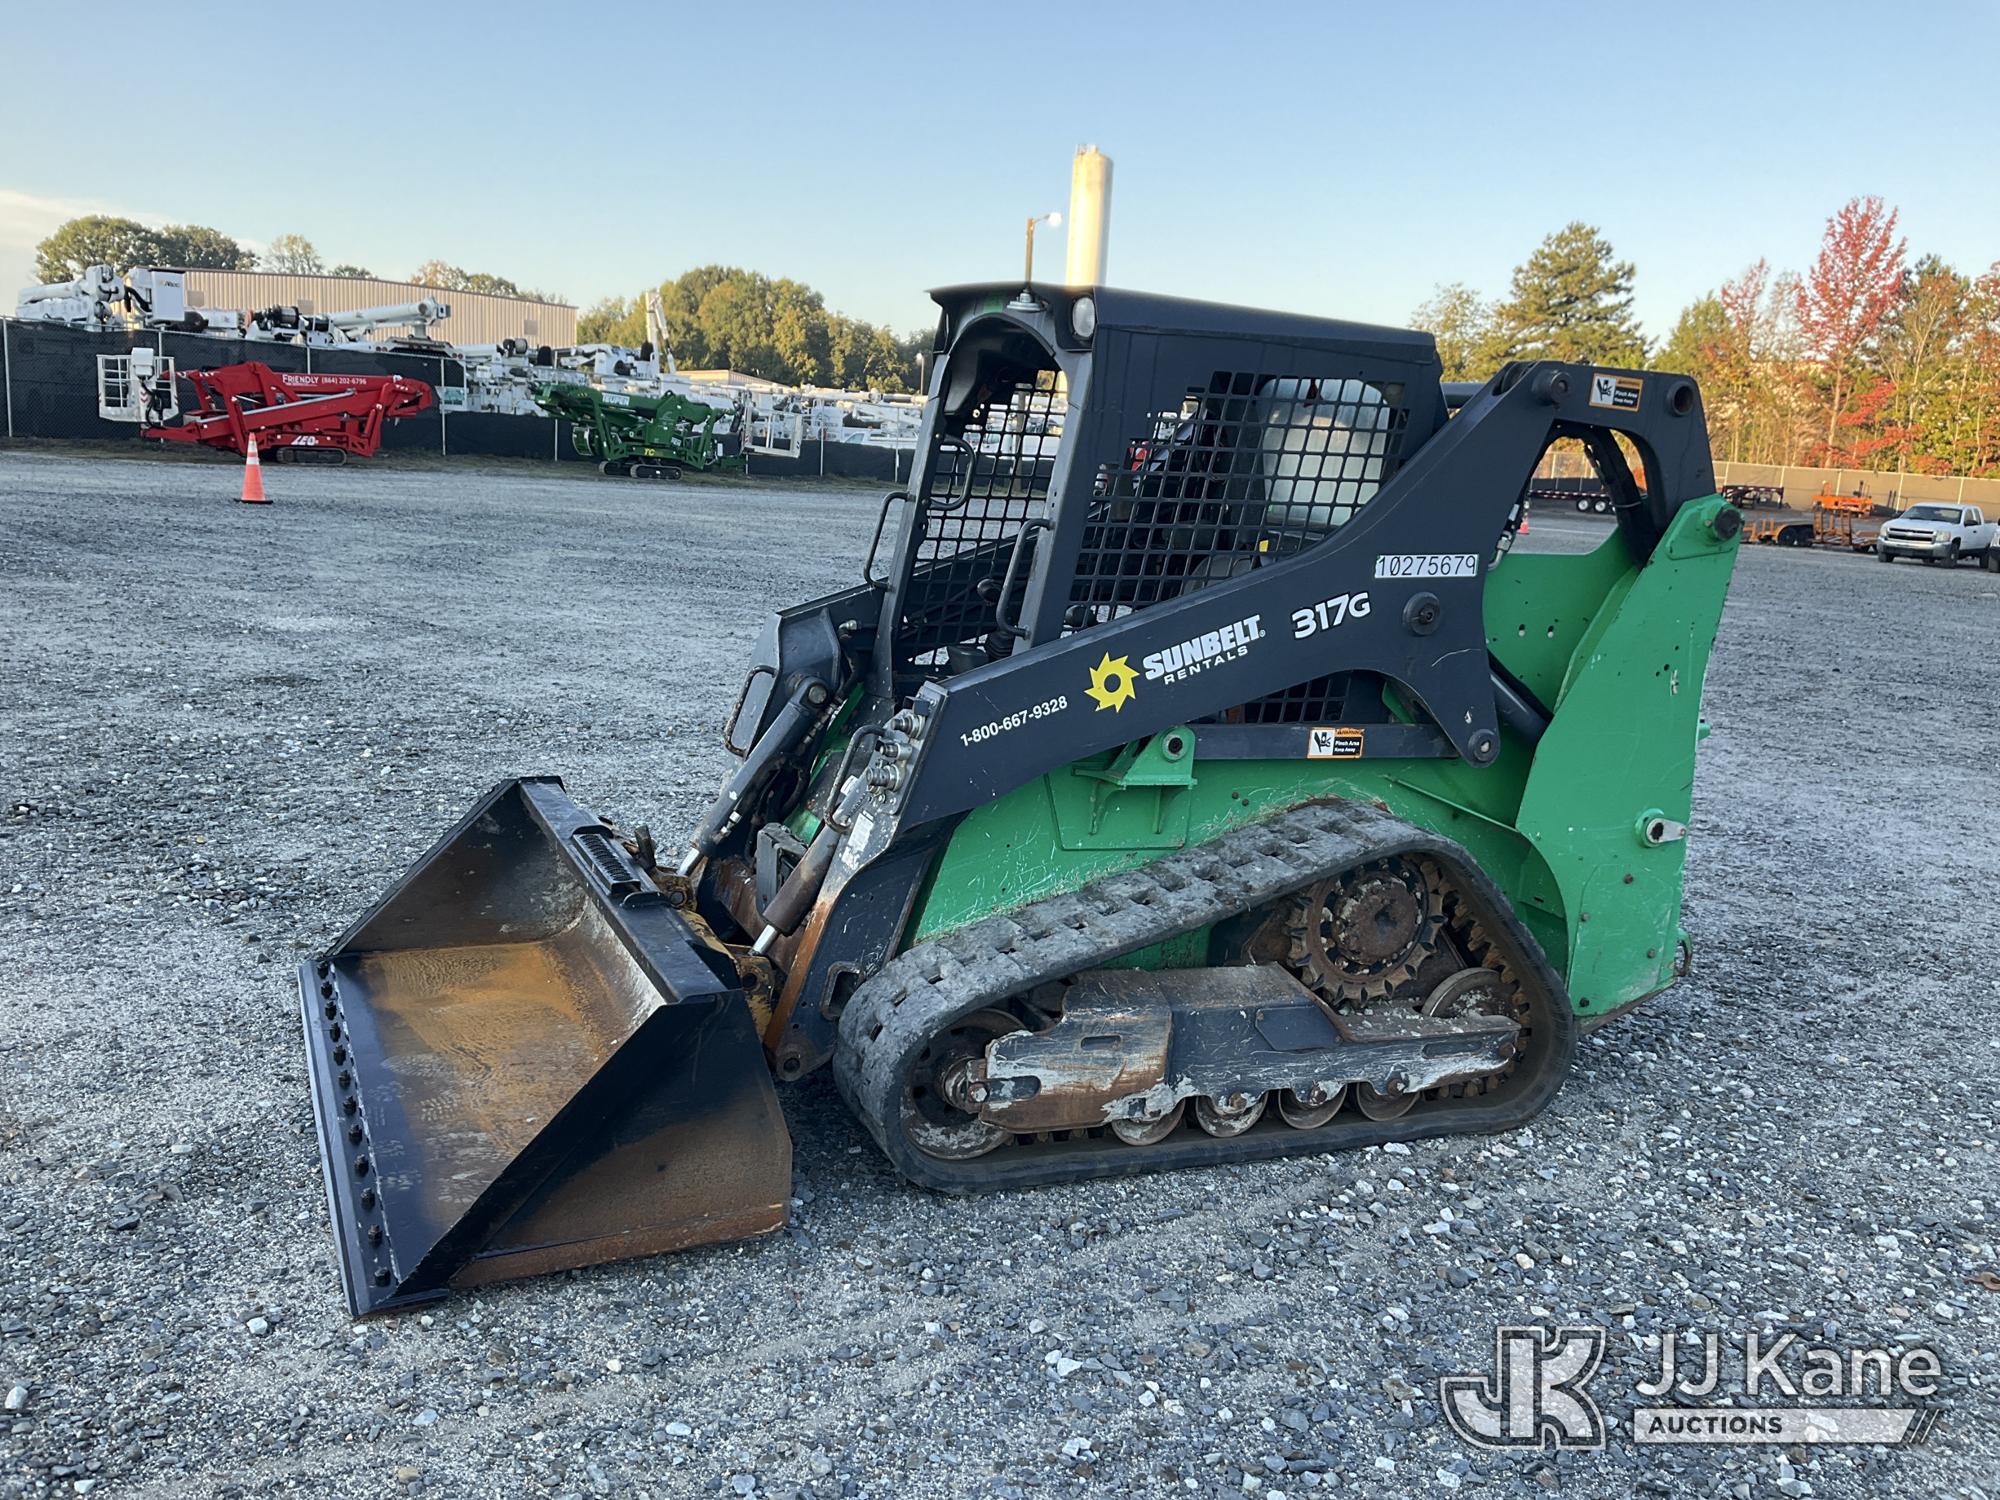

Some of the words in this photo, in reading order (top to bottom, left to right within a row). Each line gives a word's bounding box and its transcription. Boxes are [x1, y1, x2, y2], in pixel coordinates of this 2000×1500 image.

[282, 373, 319, 384] FRIENDLY
[1377, 554, 1477, 577] 10275679
[1290, 591, 1372, 640] 317G
[1163, 645, 1248, 685] RENTALS
[960, 695, 1068, 747] 1-800-667-9328
